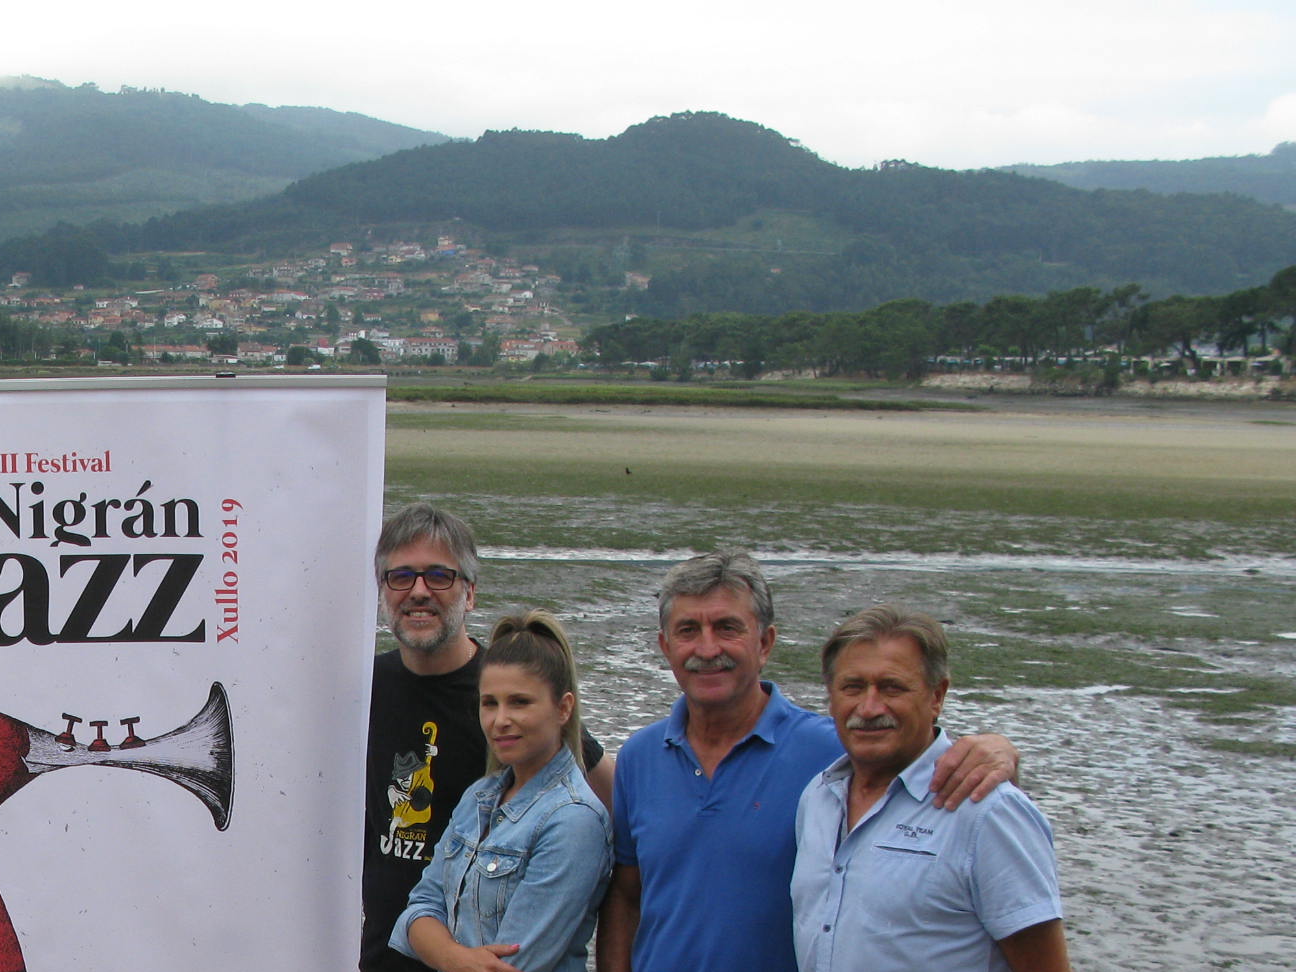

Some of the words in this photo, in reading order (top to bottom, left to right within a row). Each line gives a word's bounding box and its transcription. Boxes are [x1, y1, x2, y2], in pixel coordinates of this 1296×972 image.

[25, 451, 111, 473] Festival
[222, 499, 243, 564] 2019
[215, 571, 238, 644] Xullo
